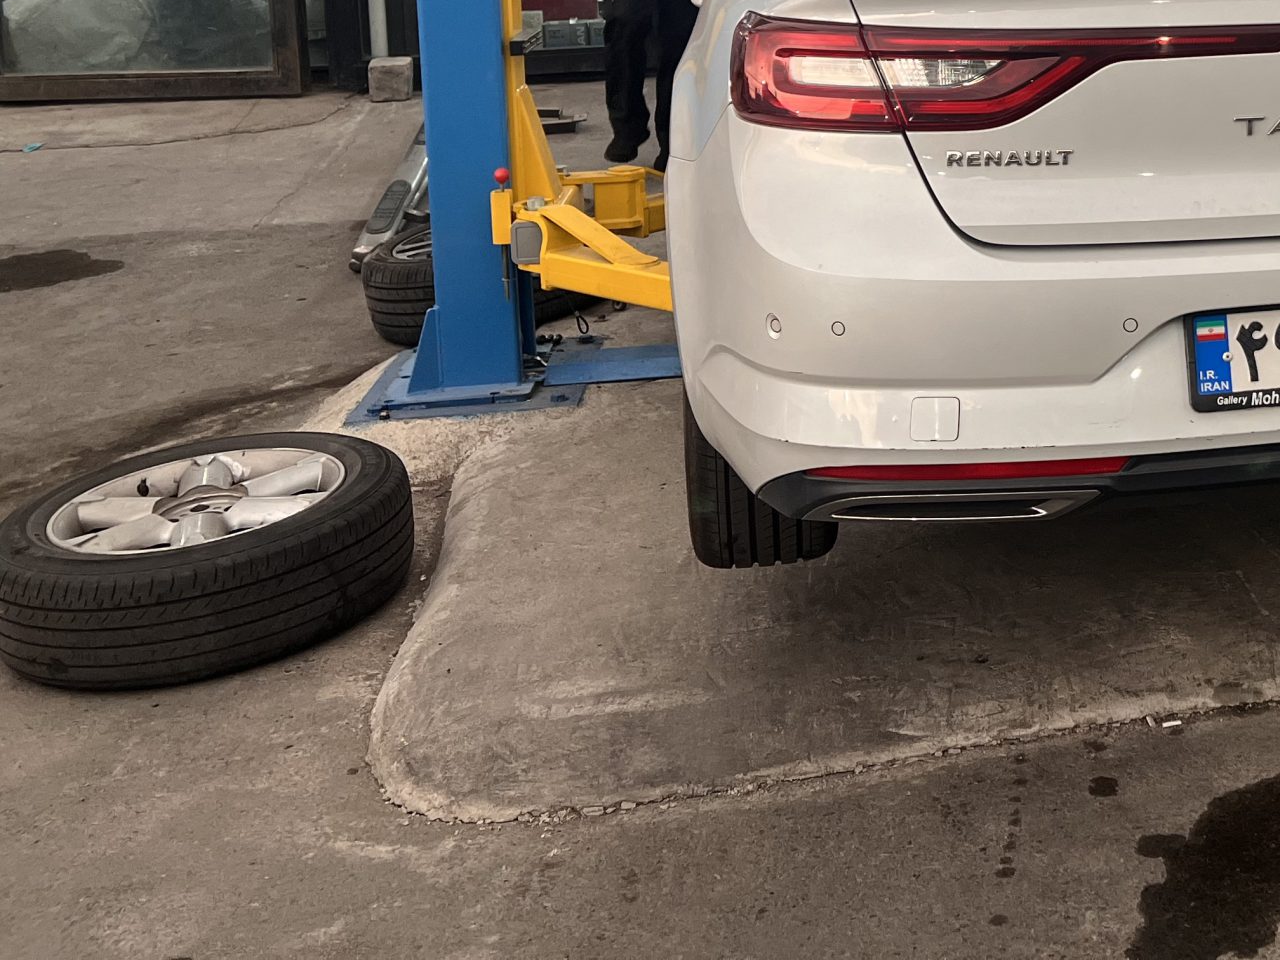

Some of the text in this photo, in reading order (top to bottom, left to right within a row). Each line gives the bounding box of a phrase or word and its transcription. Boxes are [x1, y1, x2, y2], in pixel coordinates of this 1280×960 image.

[946, 149, 1074, 167] RENAULT
[1200, 370, 1219, 380] I.R.
[1200, 380, 1230, 392] IRAN
[1217, 395, 1248, 406] Gallery
